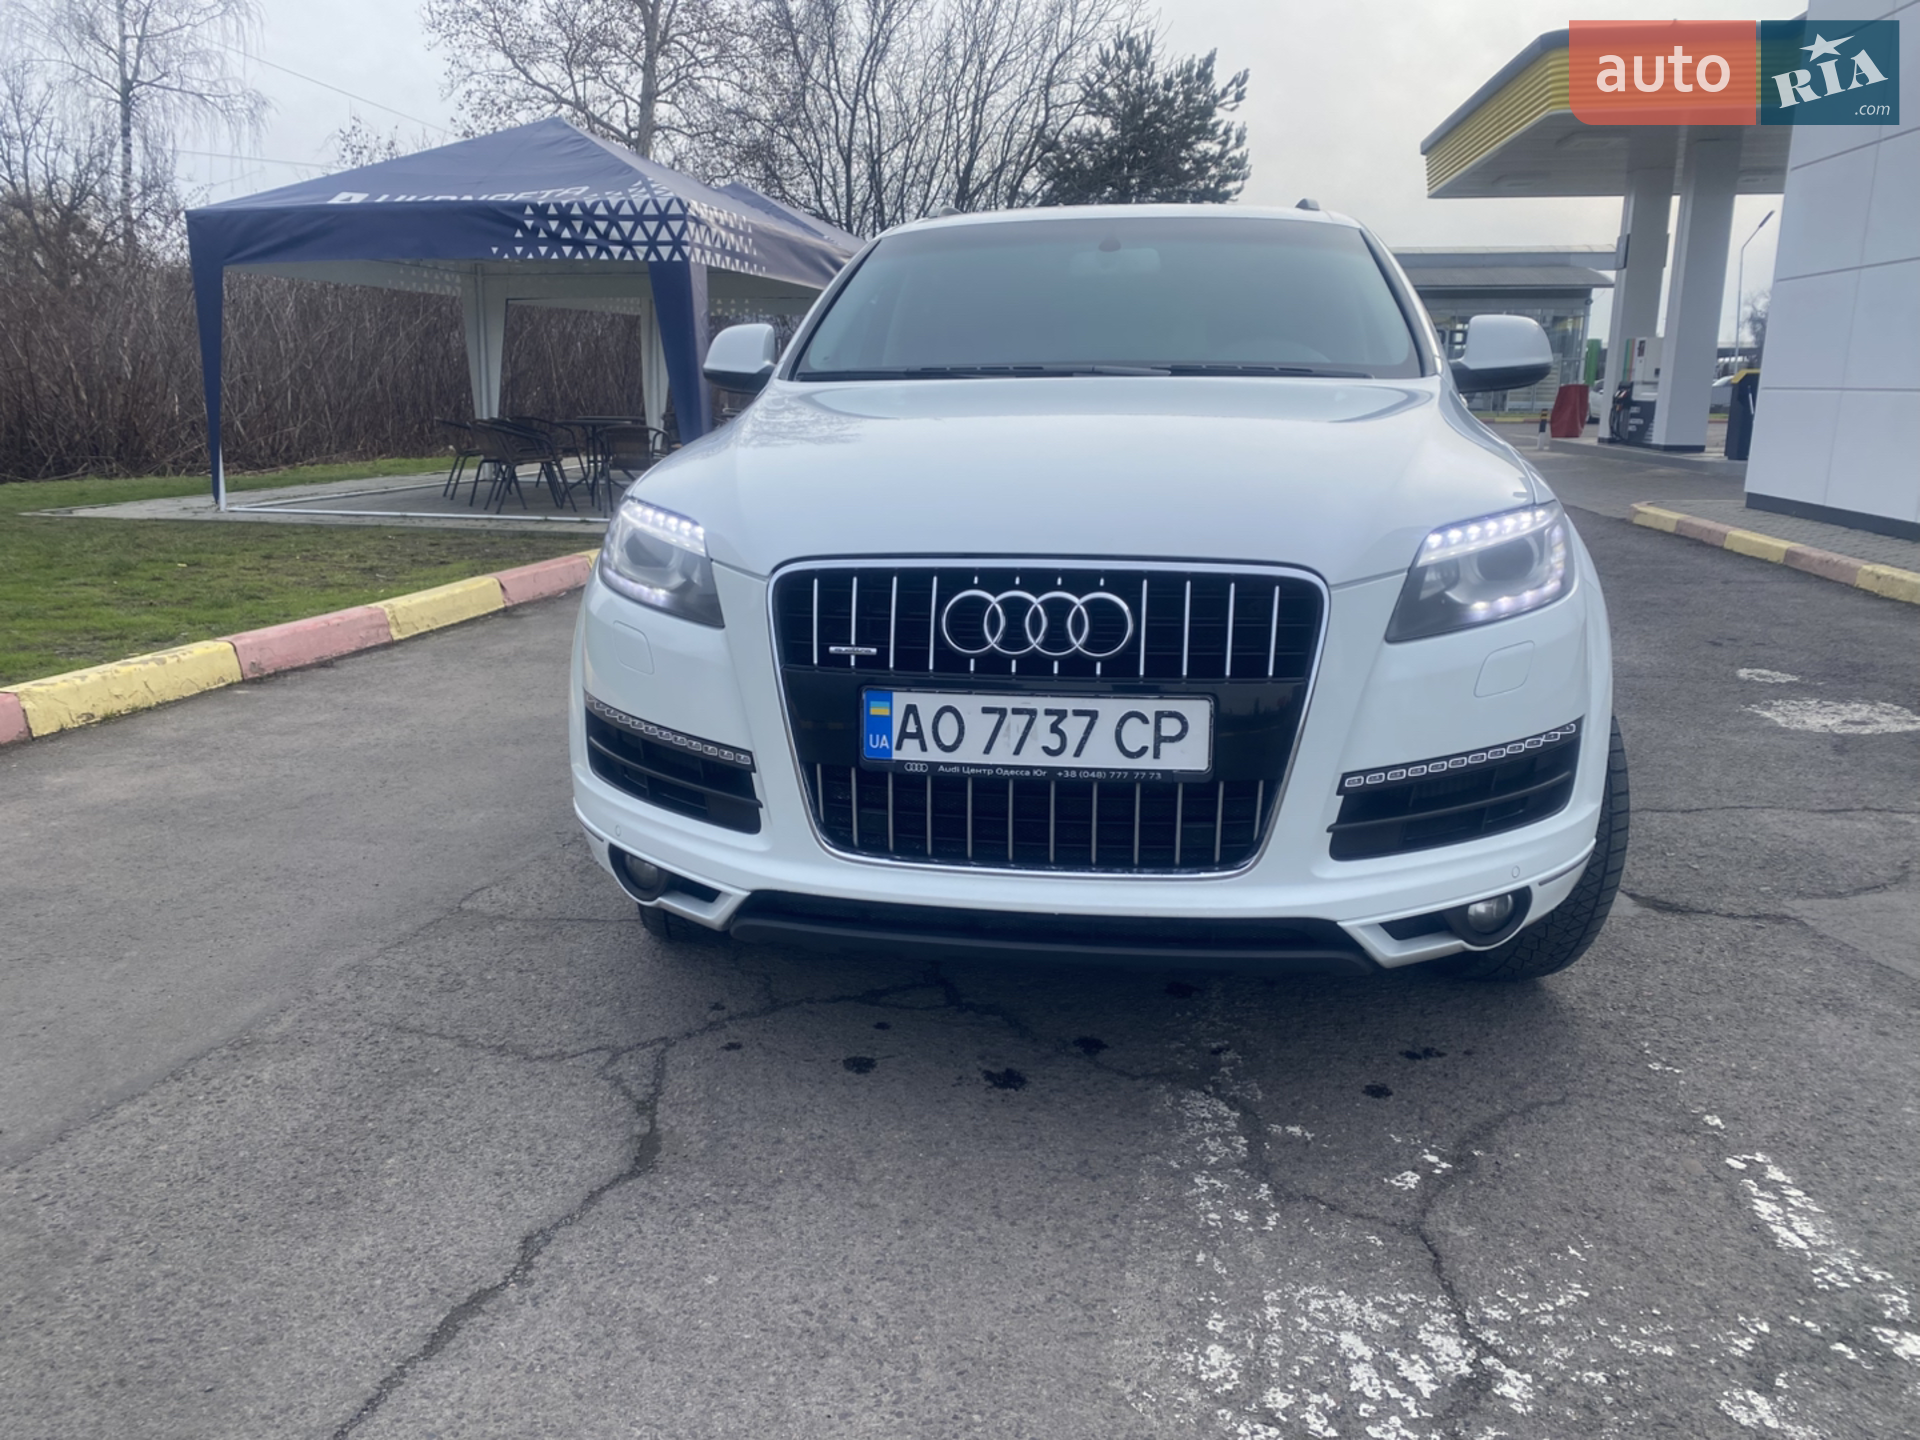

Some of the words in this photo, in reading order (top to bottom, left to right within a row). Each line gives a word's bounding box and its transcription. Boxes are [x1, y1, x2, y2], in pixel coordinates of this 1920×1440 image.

[895, 704, 966, 753] AO
[981, 706, 1099, 758] 7737
[1114, 710, 1189, 760] CP
[869, 733, 890, 749] UA
[938, 765, 960, 773] Audi
[962, 766, 994, 776] Центр
[995, 767, 1030, 776] Одесса
[1057, 770, 1077, 778] +38
[1079, 770, 1107, 780] (048)
[1109, 771, 1128, 780] 777
[1133, 772, 1146, 780] 77
